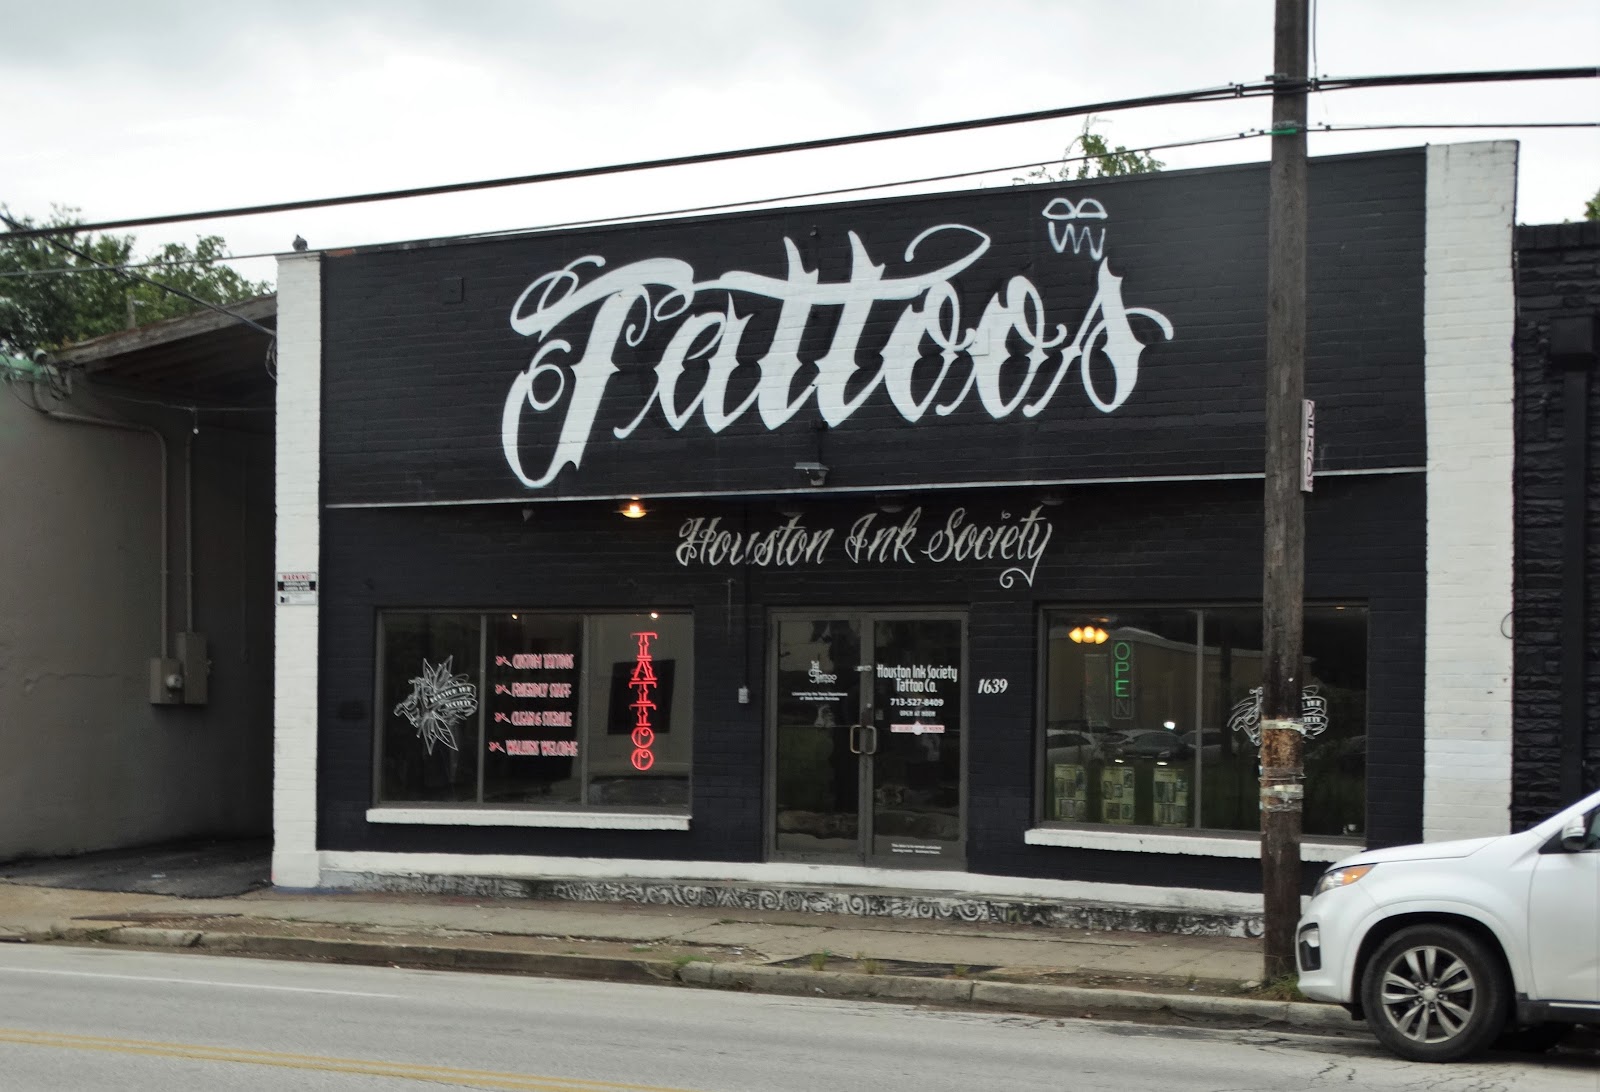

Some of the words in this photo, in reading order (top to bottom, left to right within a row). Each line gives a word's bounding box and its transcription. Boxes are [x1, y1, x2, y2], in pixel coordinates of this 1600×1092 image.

[501, 223, 1175, 488] Tattoos
[676, 514, 834, 567] Houston
[845, 507, 922, 563] Ink
[920, 505, 1053, 588] Society
[877, 664, 911, 678] Houston
[912, 664, 926, 678] Ink
[927, 664, 957, 682] Society
[896, 678, 924, 692] Tattoo
[924, 678, 938, 693] Co.
[978, 678, 1008, 694] 1639
[629, 632, 658, 770] TATTOO
